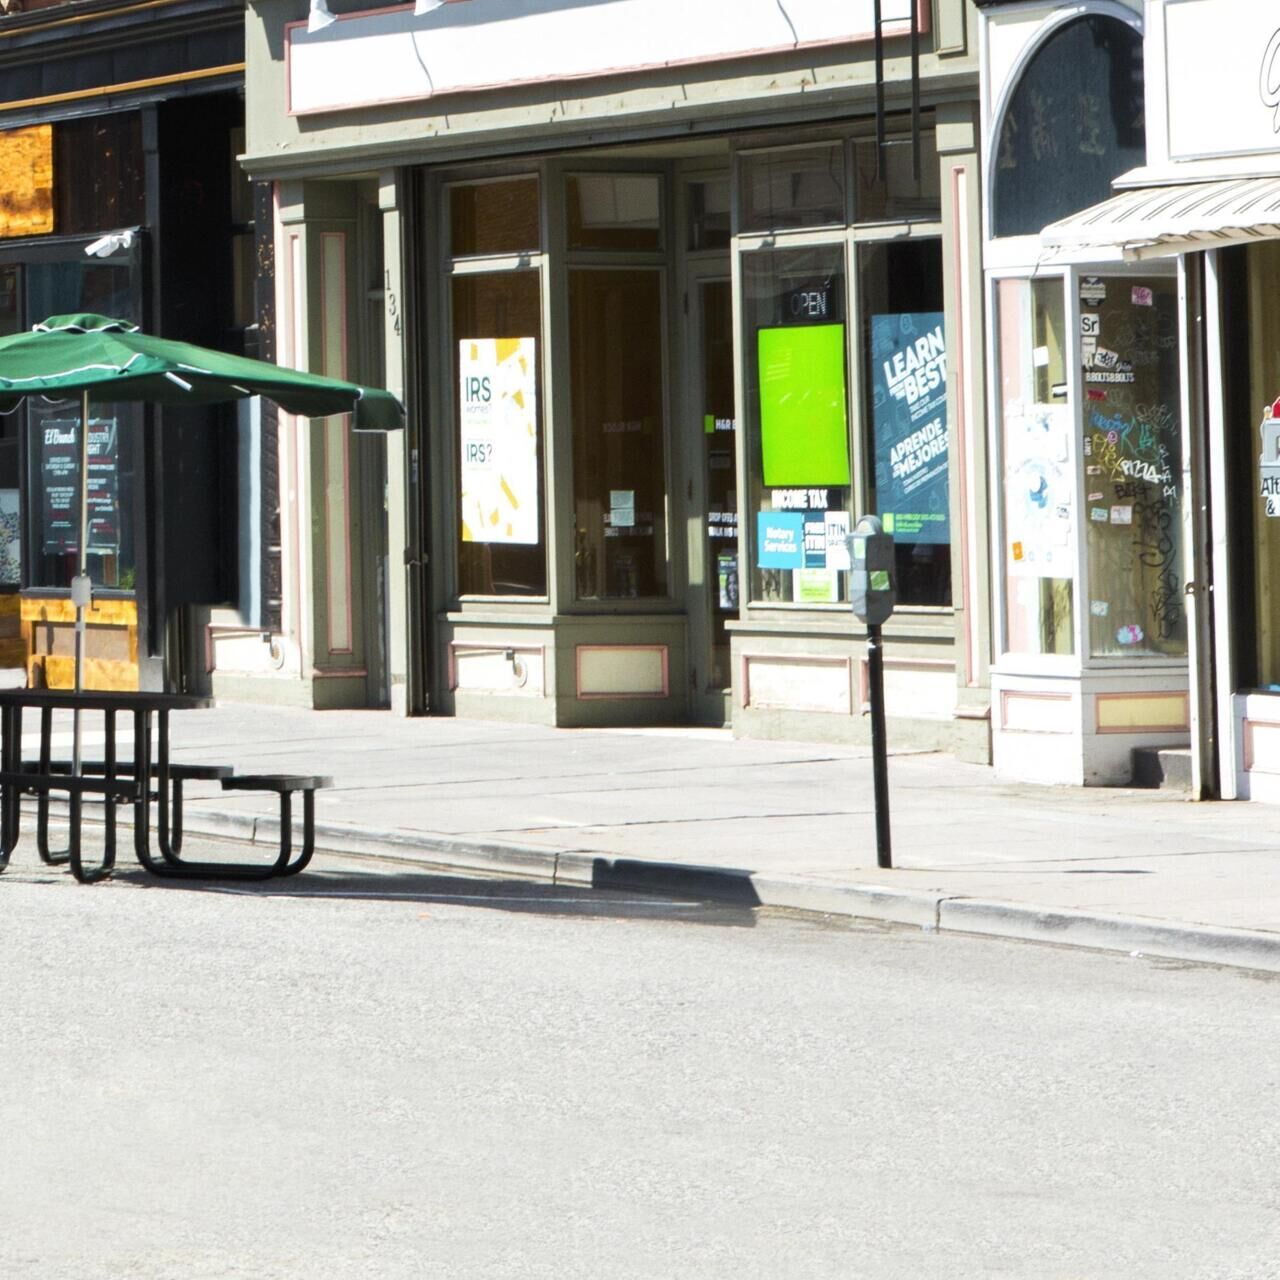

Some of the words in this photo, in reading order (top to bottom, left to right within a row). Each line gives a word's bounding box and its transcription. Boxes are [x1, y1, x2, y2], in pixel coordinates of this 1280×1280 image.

[791, 291, 826, 315] OPEN
[1081, 317, 1098, 333] Sr
[883, 325, 946, 389] LEARN
[465, 376, 492, 402] IRS
[904, 351, 947, 406] BEST
[466, 443, 493, 462] IRS?
[890, 417, 944, 465] APRENDE
[771, 489, 808, 509] INCOME
[808, 489, 828, 509] TAX
[828, 524, 846, 536] ITIN
